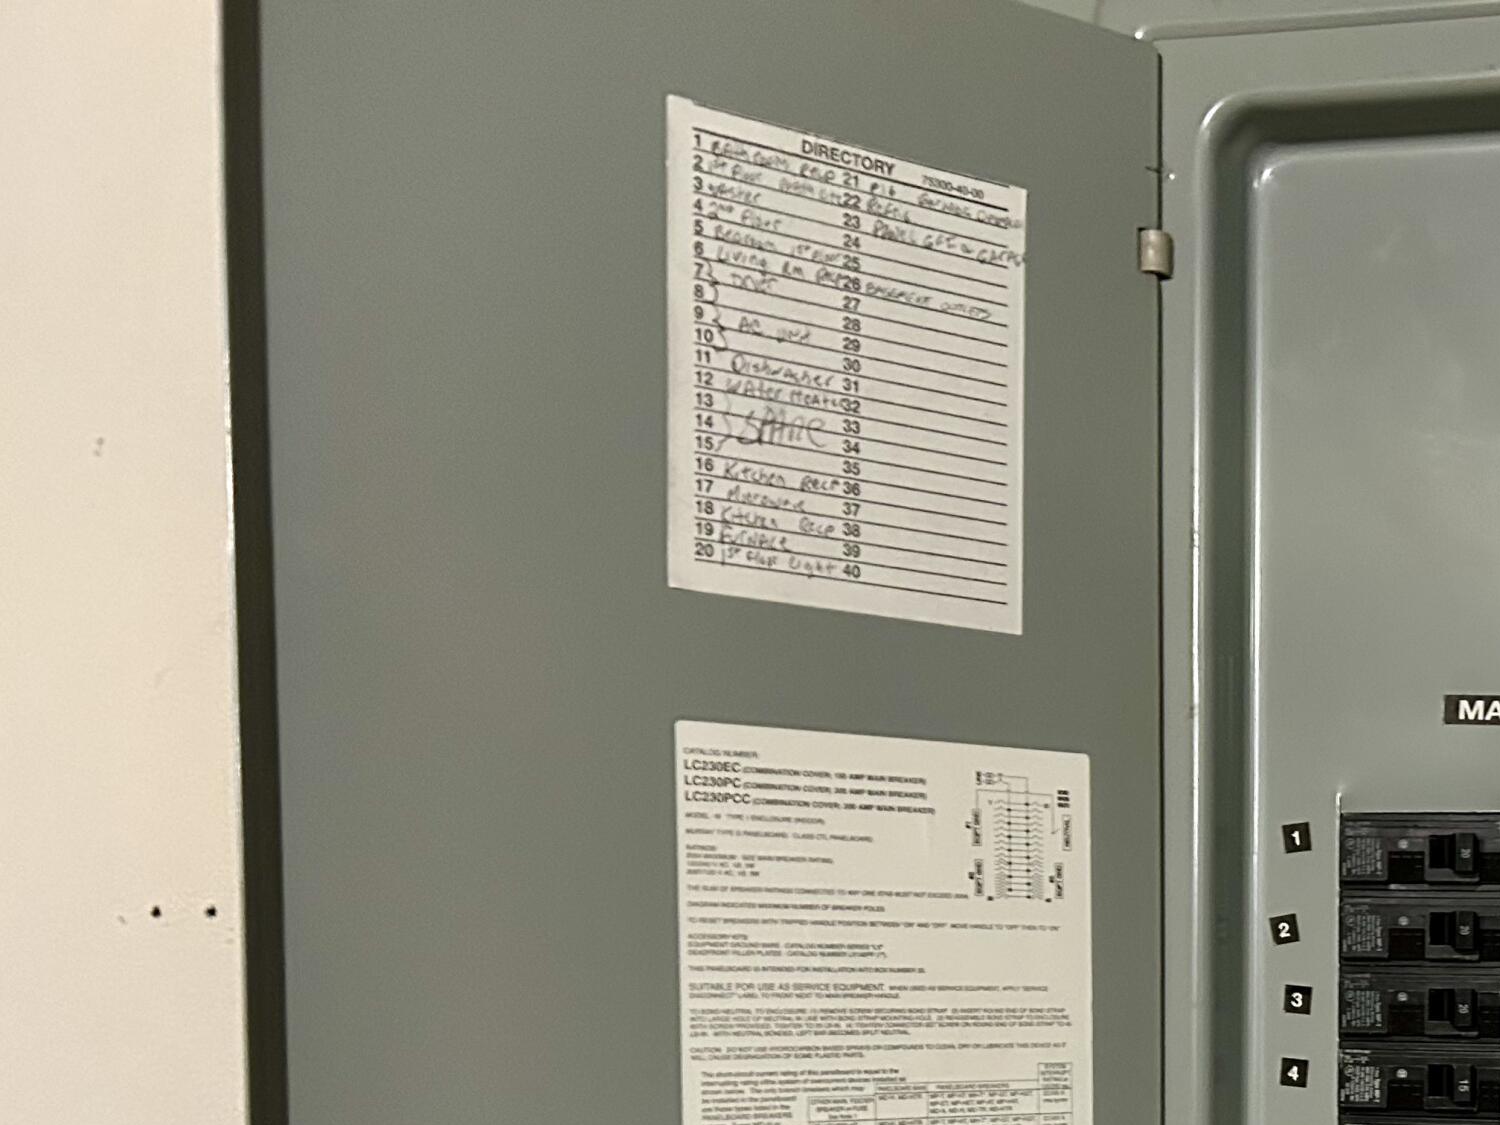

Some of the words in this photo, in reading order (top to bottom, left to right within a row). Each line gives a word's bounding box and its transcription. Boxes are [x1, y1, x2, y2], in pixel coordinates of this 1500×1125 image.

[694, 134, 701, 148] 1
[693, 156, 704, 172] 2
[802, 139, 896, 176] DIRECTORY
[693, 175, 704, 190] 3
[842, 172, 859, 187] 21
[694, 198, 704, 212] 4
[842, 192, 861, 209] 22
[694, 219, 704, 236] 5
[842, 212, 861, 229] 23
[694, 241, 704, 256] 6
[843, 234, 861, 248] 24
[694, 262, 704, 277] 7
[843, 254, 861, 271] 25
[843, 275, 861, 291] 26
[694, 284, 704, 298] 8
[843, 296, 861, 311] 27
[694, 305, 704, 319] 9
[843, 316, 861, 332] 28
[695, 328, 714, 343] 10
[843, 337, 861, 352] 29
[696, 349, 711, 363] 11
[843, 357, 861, 373] 30
[695, 371, 714, 386] 12
[843, 377, 859, 392] 31
[695, 393, 714, 407] 13
[842, 398, 861, 413] 32
[695, 414, 713, 428] 14
[843, 419, 861, 434] 33
[695, 435, 713, 450] 15
[843, 439, 860, 454] 34
[695, 457, 714, 472] 16
[843, 460, 861, 476] 35
[695, 479, 713, 493] 17
[843, 481, 861, 496] 36
[695, 500, 714, 515] 18
[843, 502, 861, 516] 37
[695, 522, 714, 536] 19
[843, 522, 861, 537] 38
[695, 542, 714, 557] 20
[843, 543, 861, 558] 39
[843, 564, 861, 578] 40
[684, 759, 742, 773] LC230EC
[684, 775, 742, 789] LC230PC
[684, 790, 751, 805] LC230PCC
[1290, 829, 1302, 847] 1
[1276, 921, 1292, 939] 2
[1289, 991, 1304, 1009] 3
[1286, 1064, 1300, 1082] 4
